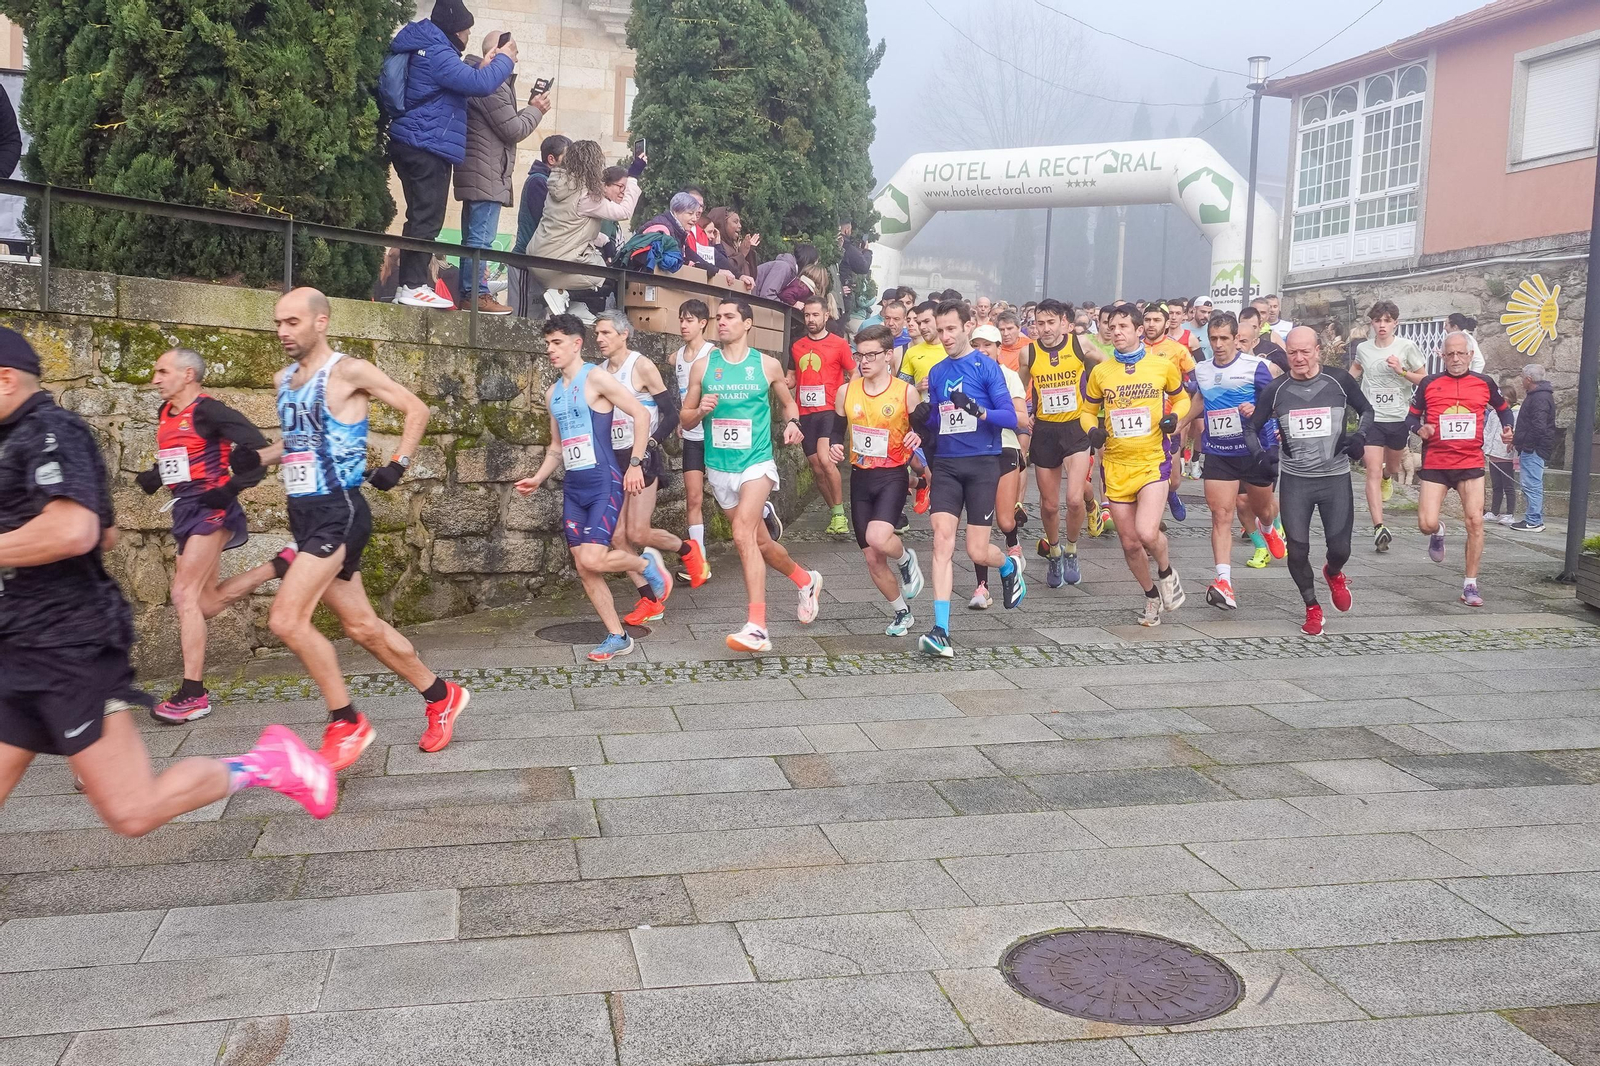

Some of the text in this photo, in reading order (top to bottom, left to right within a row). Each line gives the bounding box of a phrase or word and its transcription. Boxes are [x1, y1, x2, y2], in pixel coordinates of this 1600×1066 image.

[923, 162, 991, 182] HOTEL
[1005, 160, 1031, 179] LA
[924, 182, 1053, 198] www.hotelrectoral.com
[1036, 371, 1077, 383] TANINOS
[727, 383, 761, 391] MIGUEL
[1039, 379, 1077, 389] PONTEAREAS
[1116, 383, 1153, 392] TANINOS
[720, 391, 749, 400] MARÍN
[806, 392, 817, 402] 62
[1119, 389, 1160, 398] RUNNERS
[1375, 394, 1395, 404] 504
[1049, 395, 1070, 407] 115
[950, 412, 964, 426] 84
[1120, 416, 1143, 430] 114
[1212, 417, 1233, 430] 172
[1299, 417, 1322, 430] 159
[1448, 422, 1470, 433] 157
[723, 428, 739, 441] 65
[864, 436, 873, 448] 8
[568, 446, 581, 460] 10
